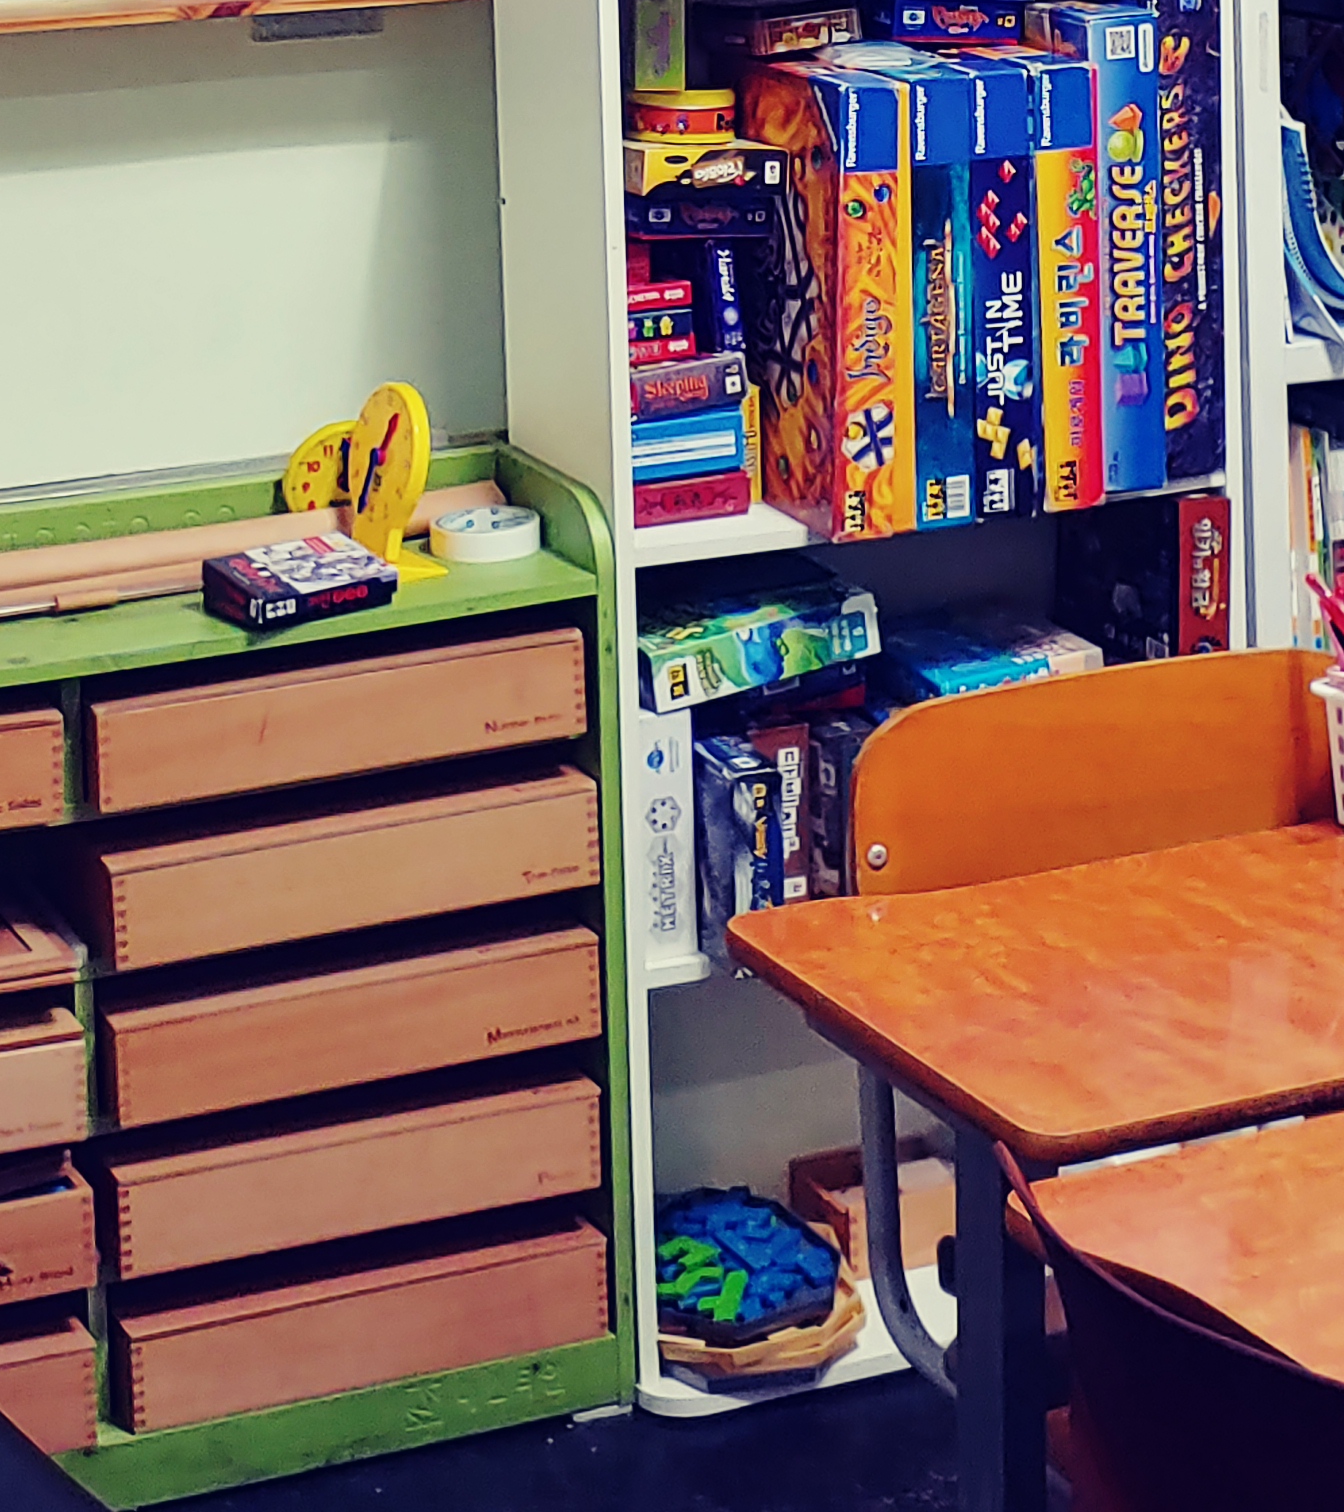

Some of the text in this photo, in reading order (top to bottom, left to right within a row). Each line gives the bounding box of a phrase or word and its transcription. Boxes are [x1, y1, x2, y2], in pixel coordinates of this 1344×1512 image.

[1001, 270, 1024, 353] TIME
[1053, 224, 1094, 369] 라비린스
[1107, 165, 1146, 349] TRAVERSE
[1162, 82, 1202, 435] DINO CHECKERS
[986, 336, 1005, 406] JUST
